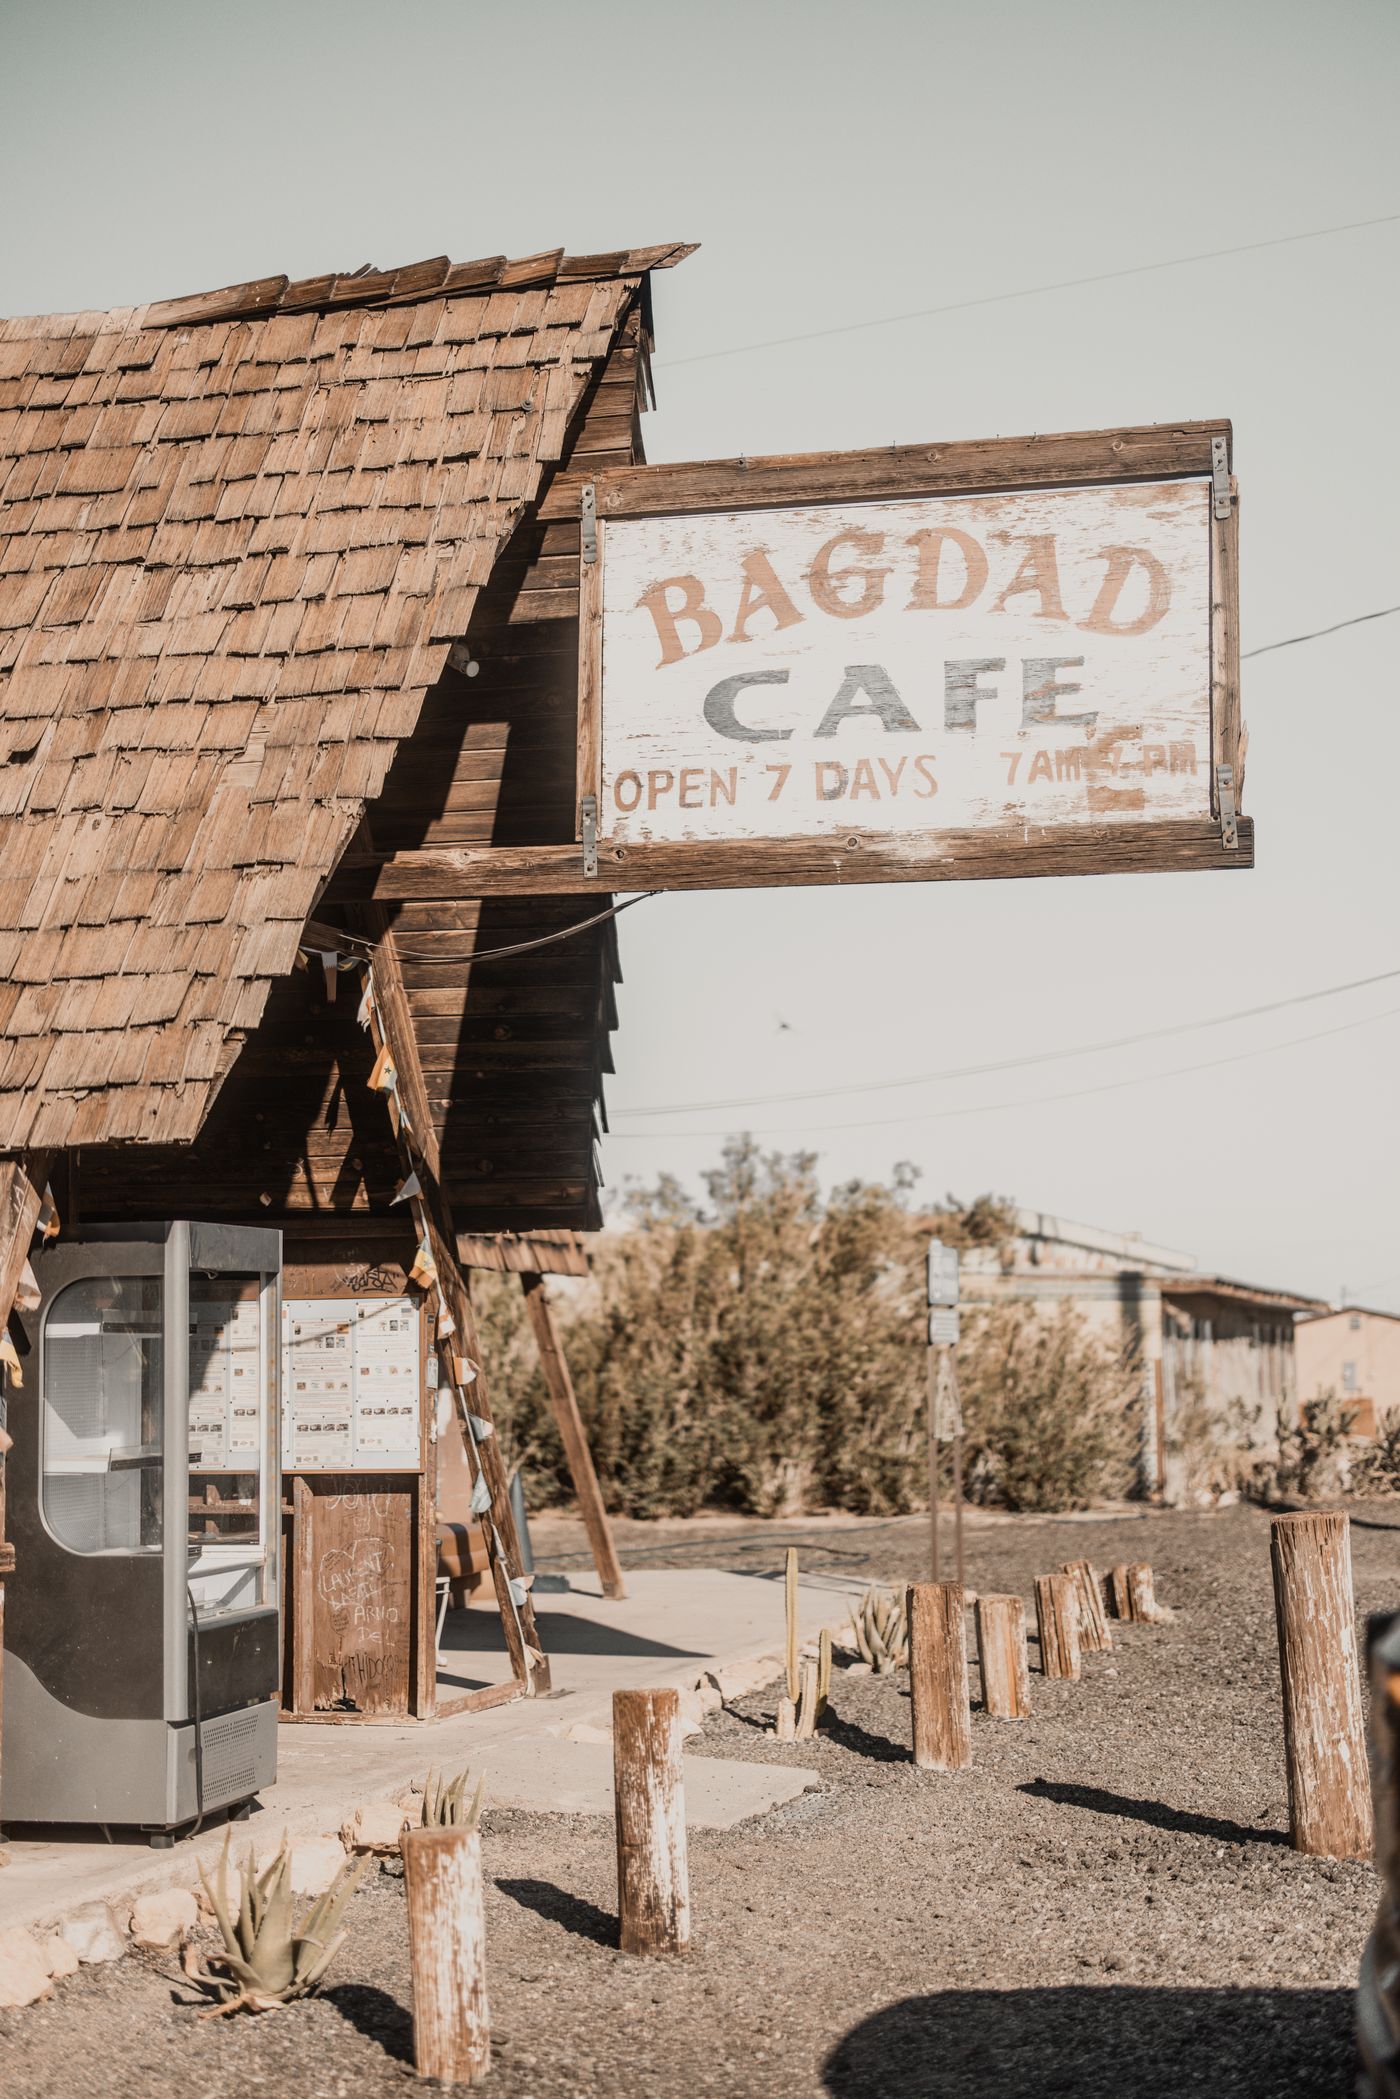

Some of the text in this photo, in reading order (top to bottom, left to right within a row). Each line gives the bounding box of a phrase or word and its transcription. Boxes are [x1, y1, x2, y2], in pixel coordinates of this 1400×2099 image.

[634, 527, 1176, 670] BAGDAD
[703, 655, 1099, 743] CAFE
[613, 766, 738, 812] OPEN
[765, 763, 792, 801] 7
[815, 754, 938, 801] DAYS
